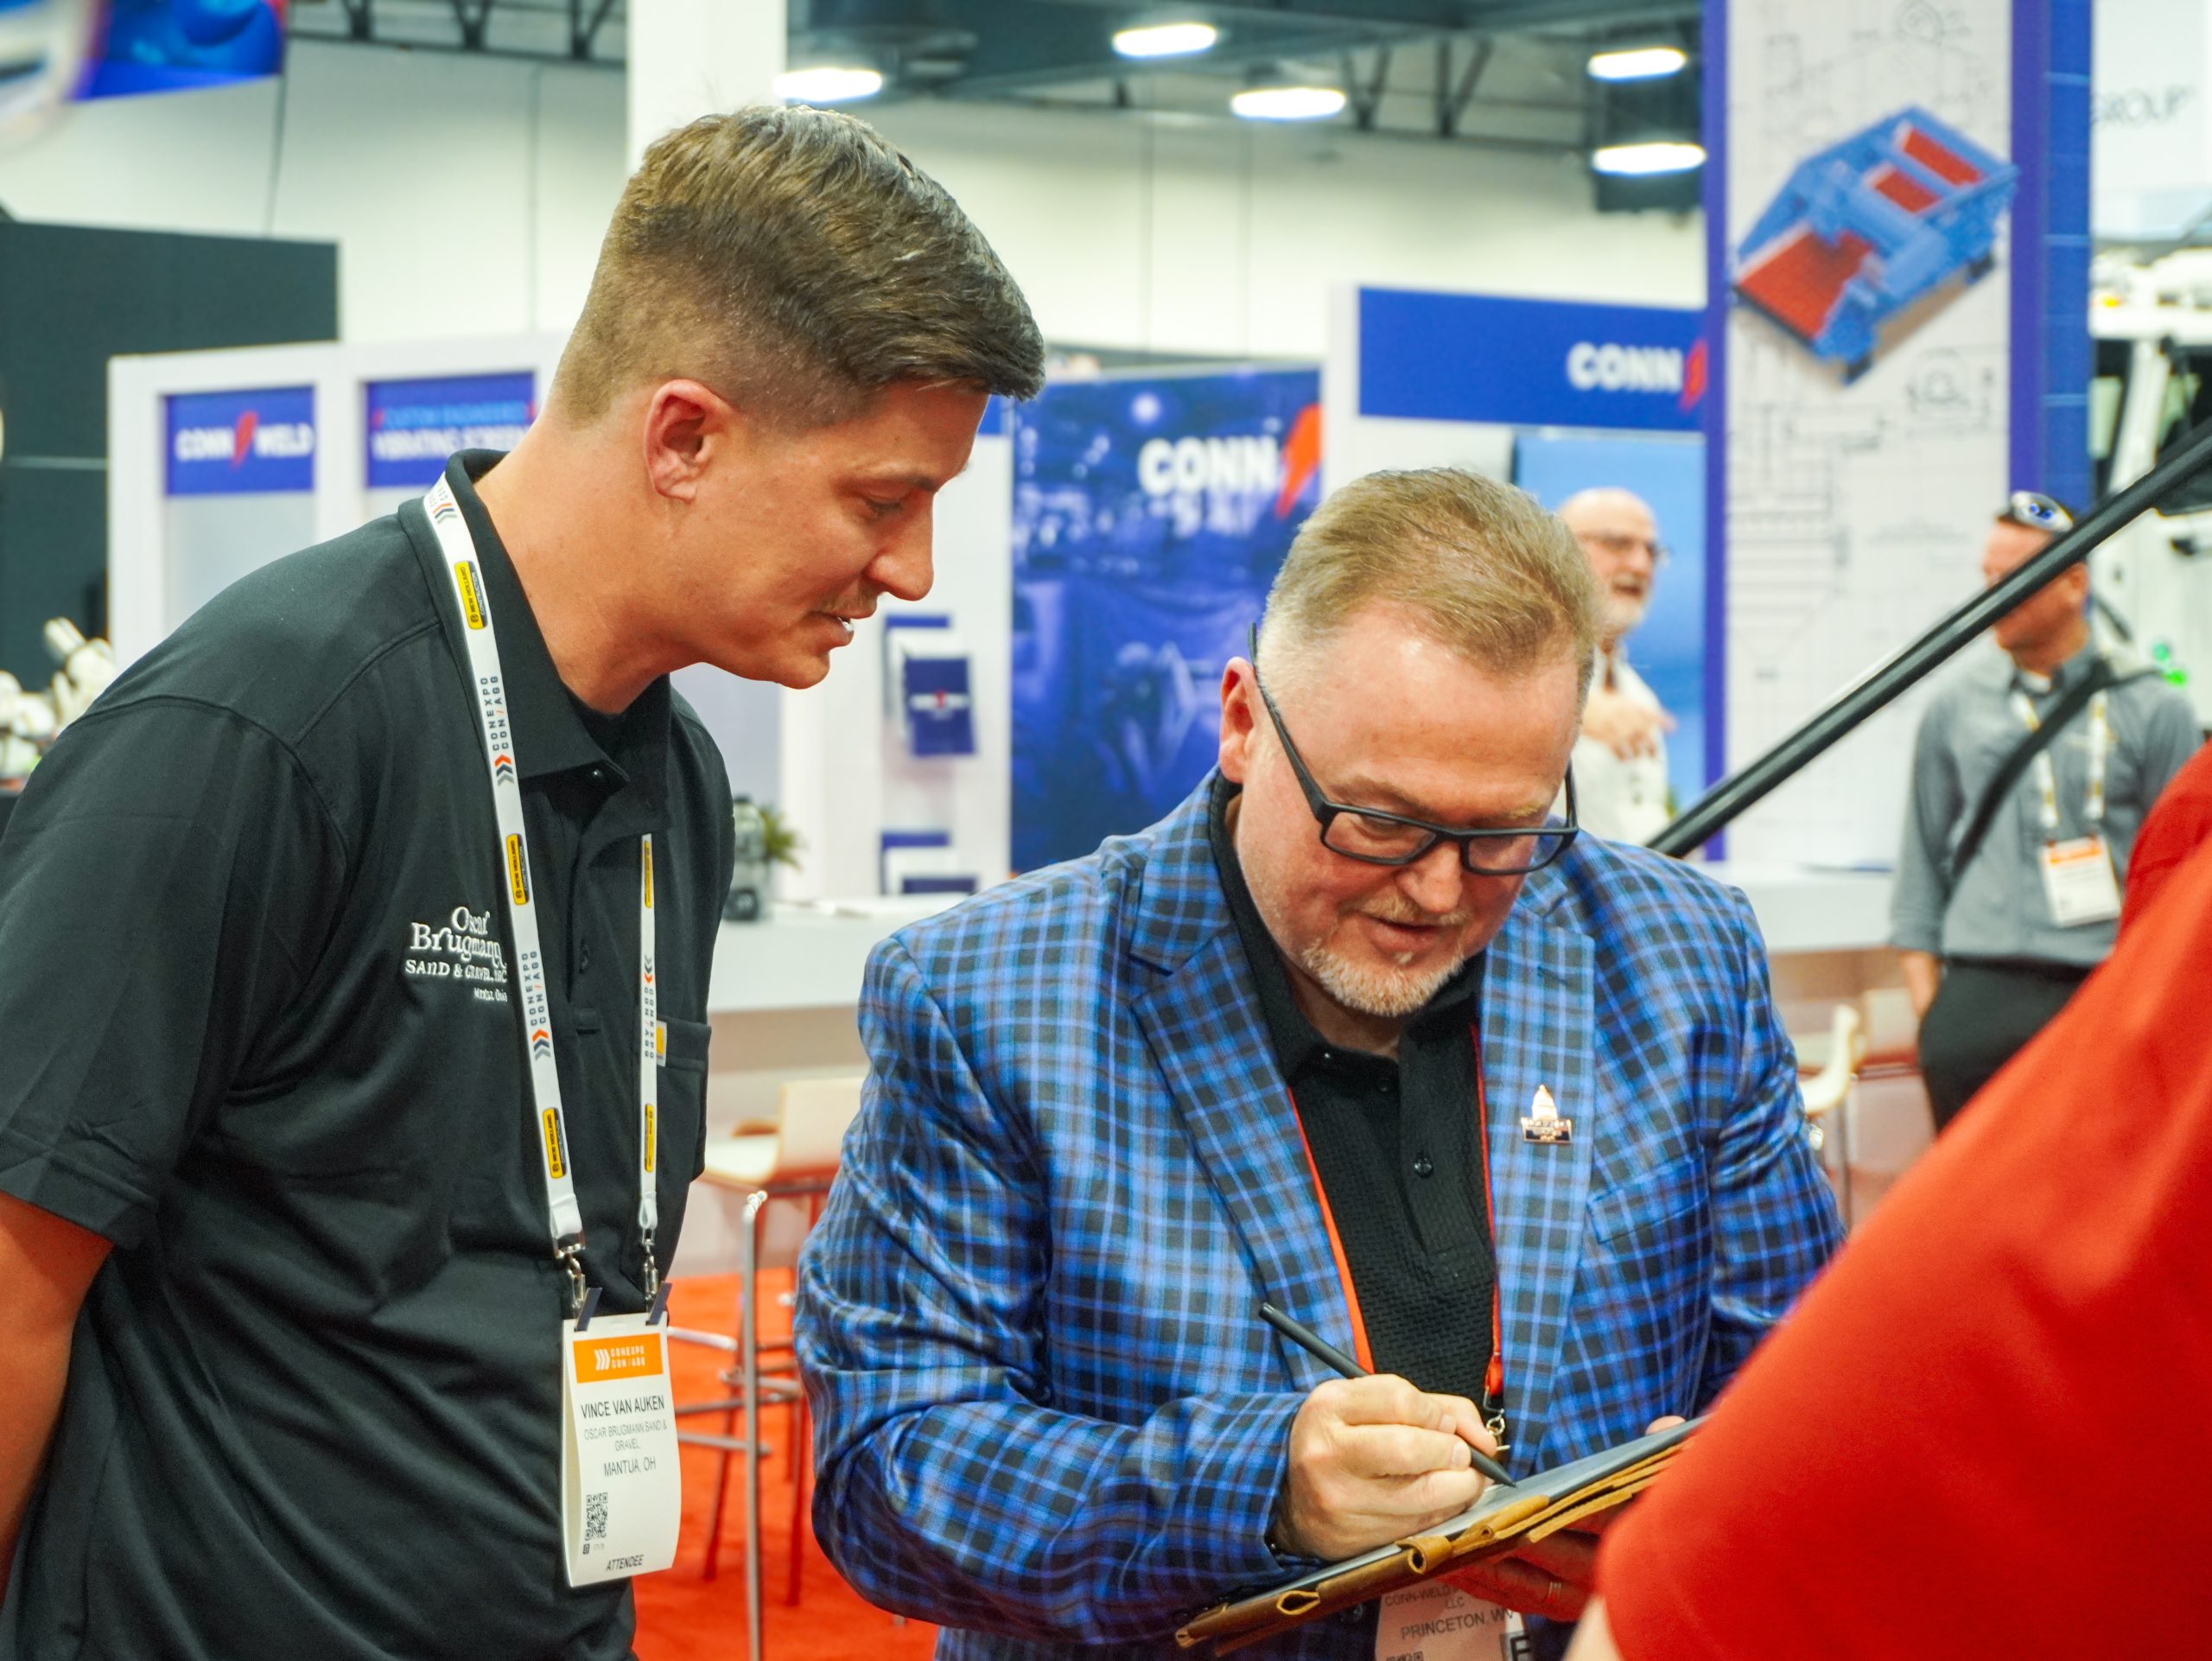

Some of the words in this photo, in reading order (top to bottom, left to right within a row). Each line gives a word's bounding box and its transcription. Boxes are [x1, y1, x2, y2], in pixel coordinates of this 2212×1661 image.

[1567, 341, 1683, 394] CONN
[176, 427, 232, 461] CONN
[256, 423, 314, 457] WELD
[1138, 436, 1280, 499] CONN
[480, 678, 499, 751] CONEXPO
[451, 906, 491, 935] Oscar
[410, 921, 507, 969] Brugmann
[454, 963, 463, 977] &
[521, 953, 537, 1026] CONEXPO
[610, 1345, 645, 1358] CONEXPO
[580, 1401, 611, 1419] VINCE
[613, 1397, 632, 1415] VAN
[634, 1394, 664, 1412] AUKEN
[584, 1426, 607, 1441] OSCAR
[608, 1422, 645, 1438] BRUGMANN
[645, 1420, 664, 1433] SAND
[643, 1456, 657, 1472] OH
[606, 1554, 645, 1572] ATTENDEE
